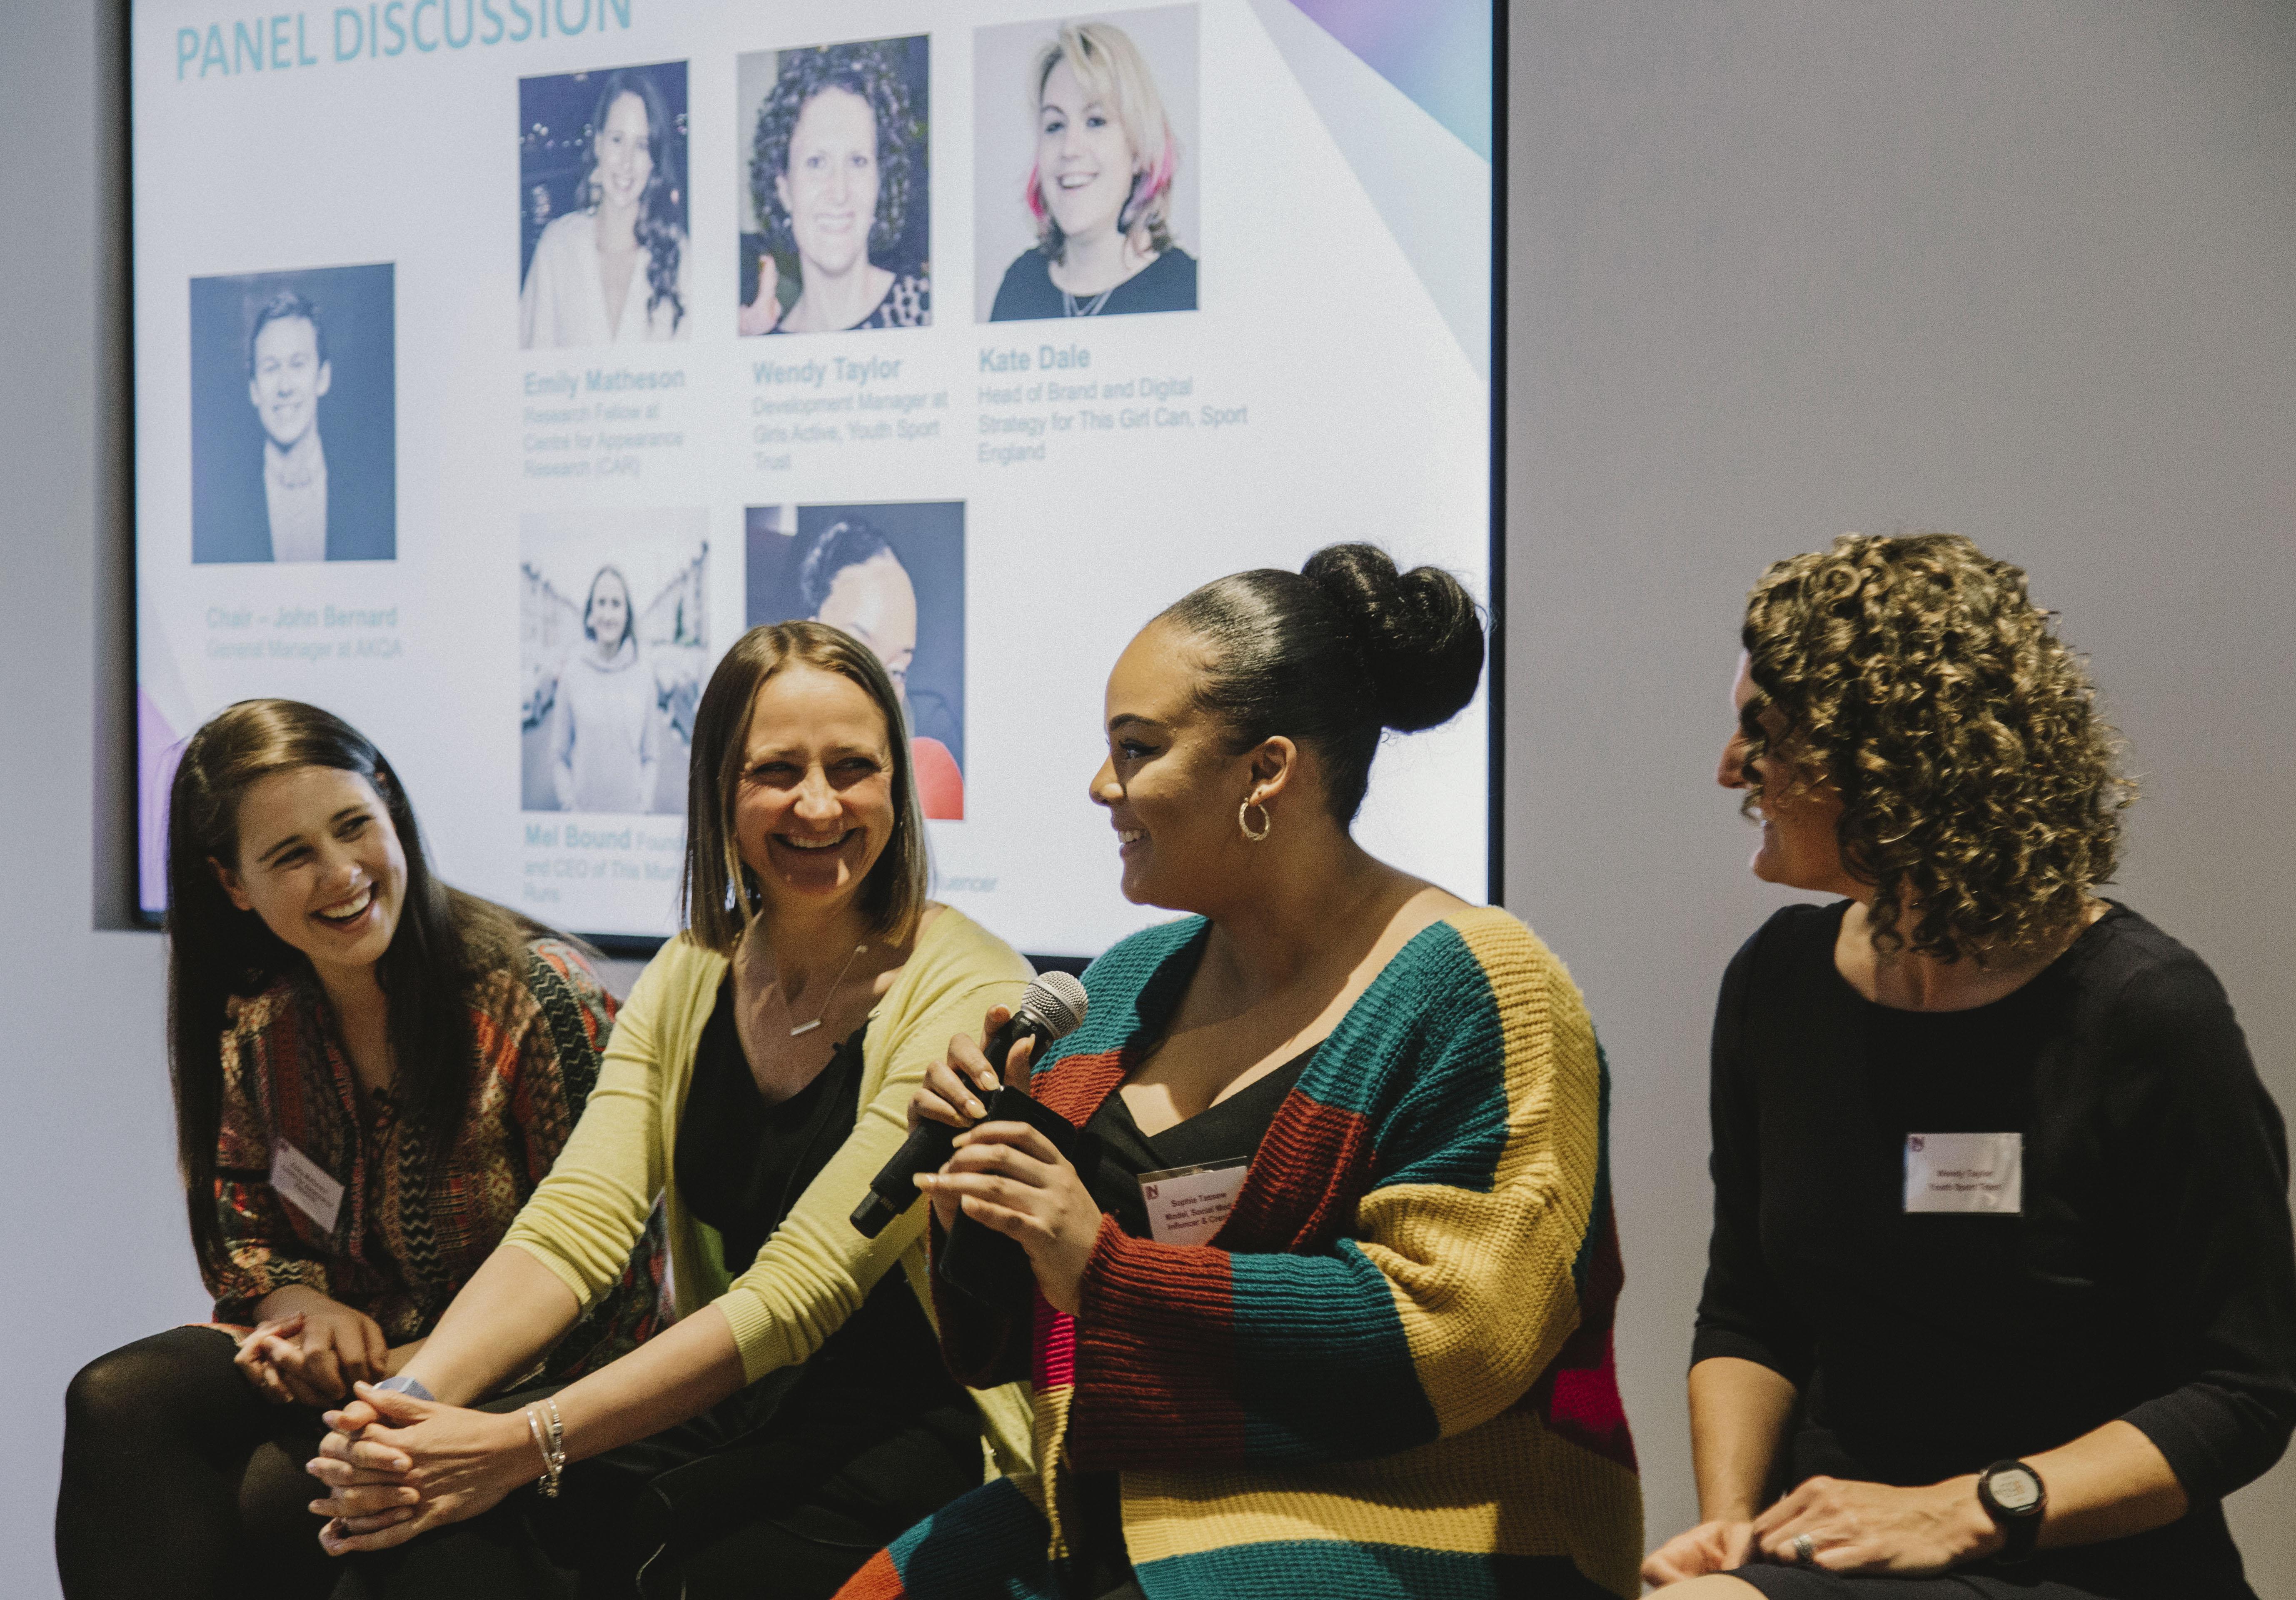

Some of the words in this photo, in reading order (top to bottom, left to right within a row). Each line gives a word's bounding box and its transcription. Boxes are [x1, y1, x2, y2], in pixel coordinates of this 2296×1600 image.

[177, 12, 318, 80] PANEL
[334, 0, 631, 62] DISCUSSION
[979, 347, 1031, 372] Kate
[1038, 344, 1091, 370] Dale
[524, 371, 578, 399] Emily
[585, 368, 685, 392] Matheson
[753, 361, 826, 388] Wendy
[834, 355, 902, 386] Taylor
[753, 395, 853, 416] Development
[858, 392, 926, 413] Manager
[932, 390, 948, 408] at
[978, 385, 1023, 404] Head
[1026, 383, 1043, 402] of
[1047, 381, 1098, 401] Brand
[1103, 380, 1135, 398] and
[1140, 377, 1193, 402] Digital
[897, 418, 940, 440] Sport
[978, 414, 1046, 437] Strategy
[1051, 412, 1073, 431] for
[1078, 410, 1114, 429] This
[1119, 408, 1150, 429] Girl
[1154, 407, 1195, 428] Can,
[1200, 405, 1248, 428] Sport
[978, 442, 1046, 465] England
[207, 605, 252, 629] Chair
[274, 606, 318, 628] John
[324, 604, 398, 628] Bernard
[525, 825, 558, 847] Mel
[566, 824, 631, 850] Bound
[1170, 1198, 1197, 1208] Sophie
[1190, 1206, 1214, 1216] Social
